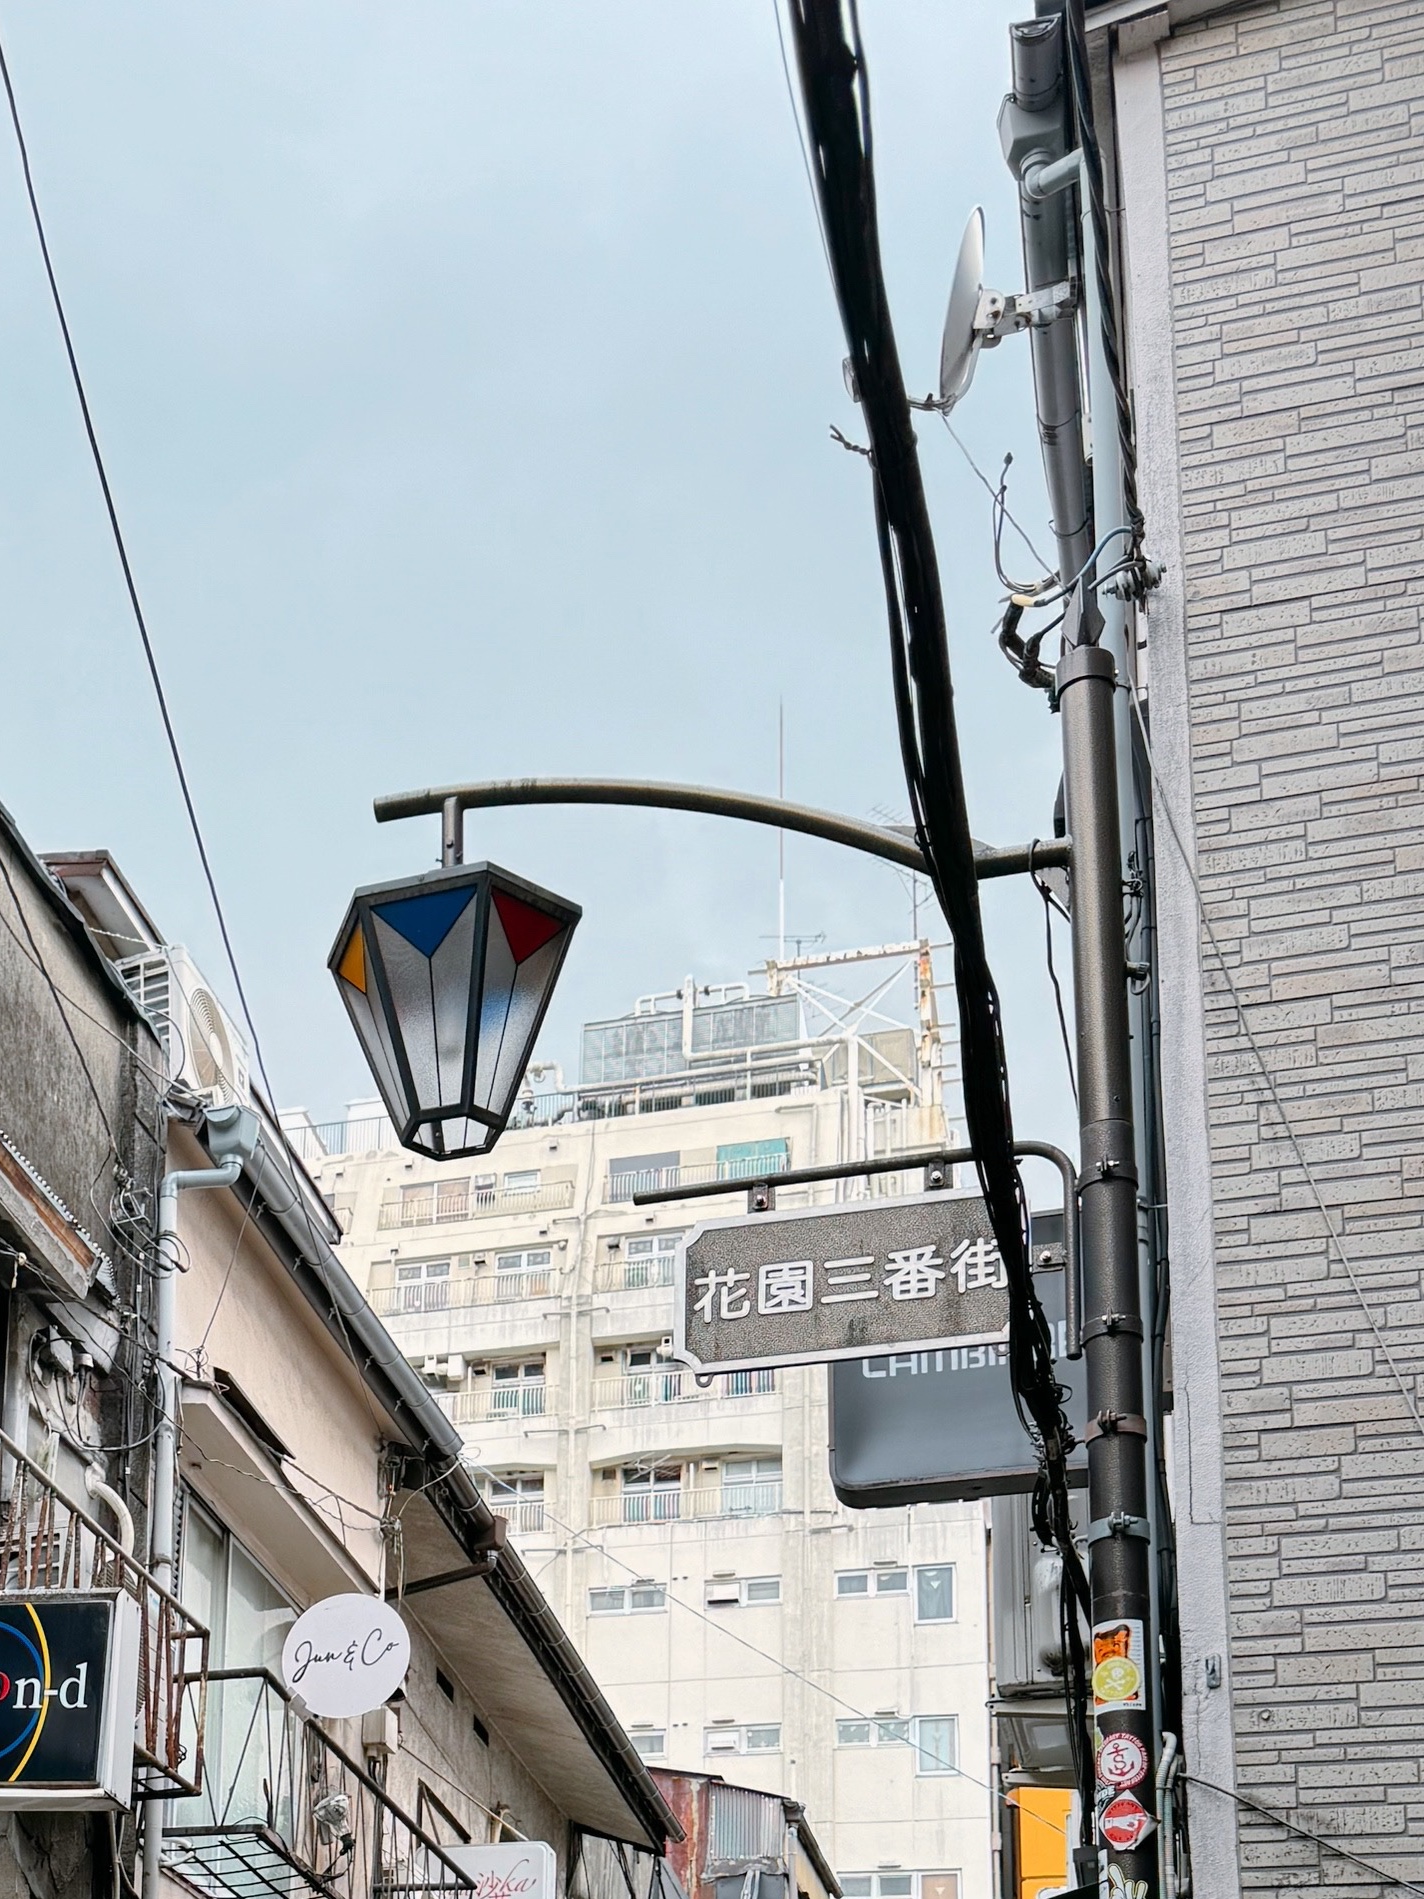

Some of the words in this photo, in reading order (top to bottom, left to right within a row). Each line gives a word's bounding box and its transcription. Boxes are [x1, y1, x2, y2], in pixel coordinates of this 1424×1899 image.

[693, 1237, 1009, 1323] 花園三番街
[362, 1628, 399, 1666] Co
